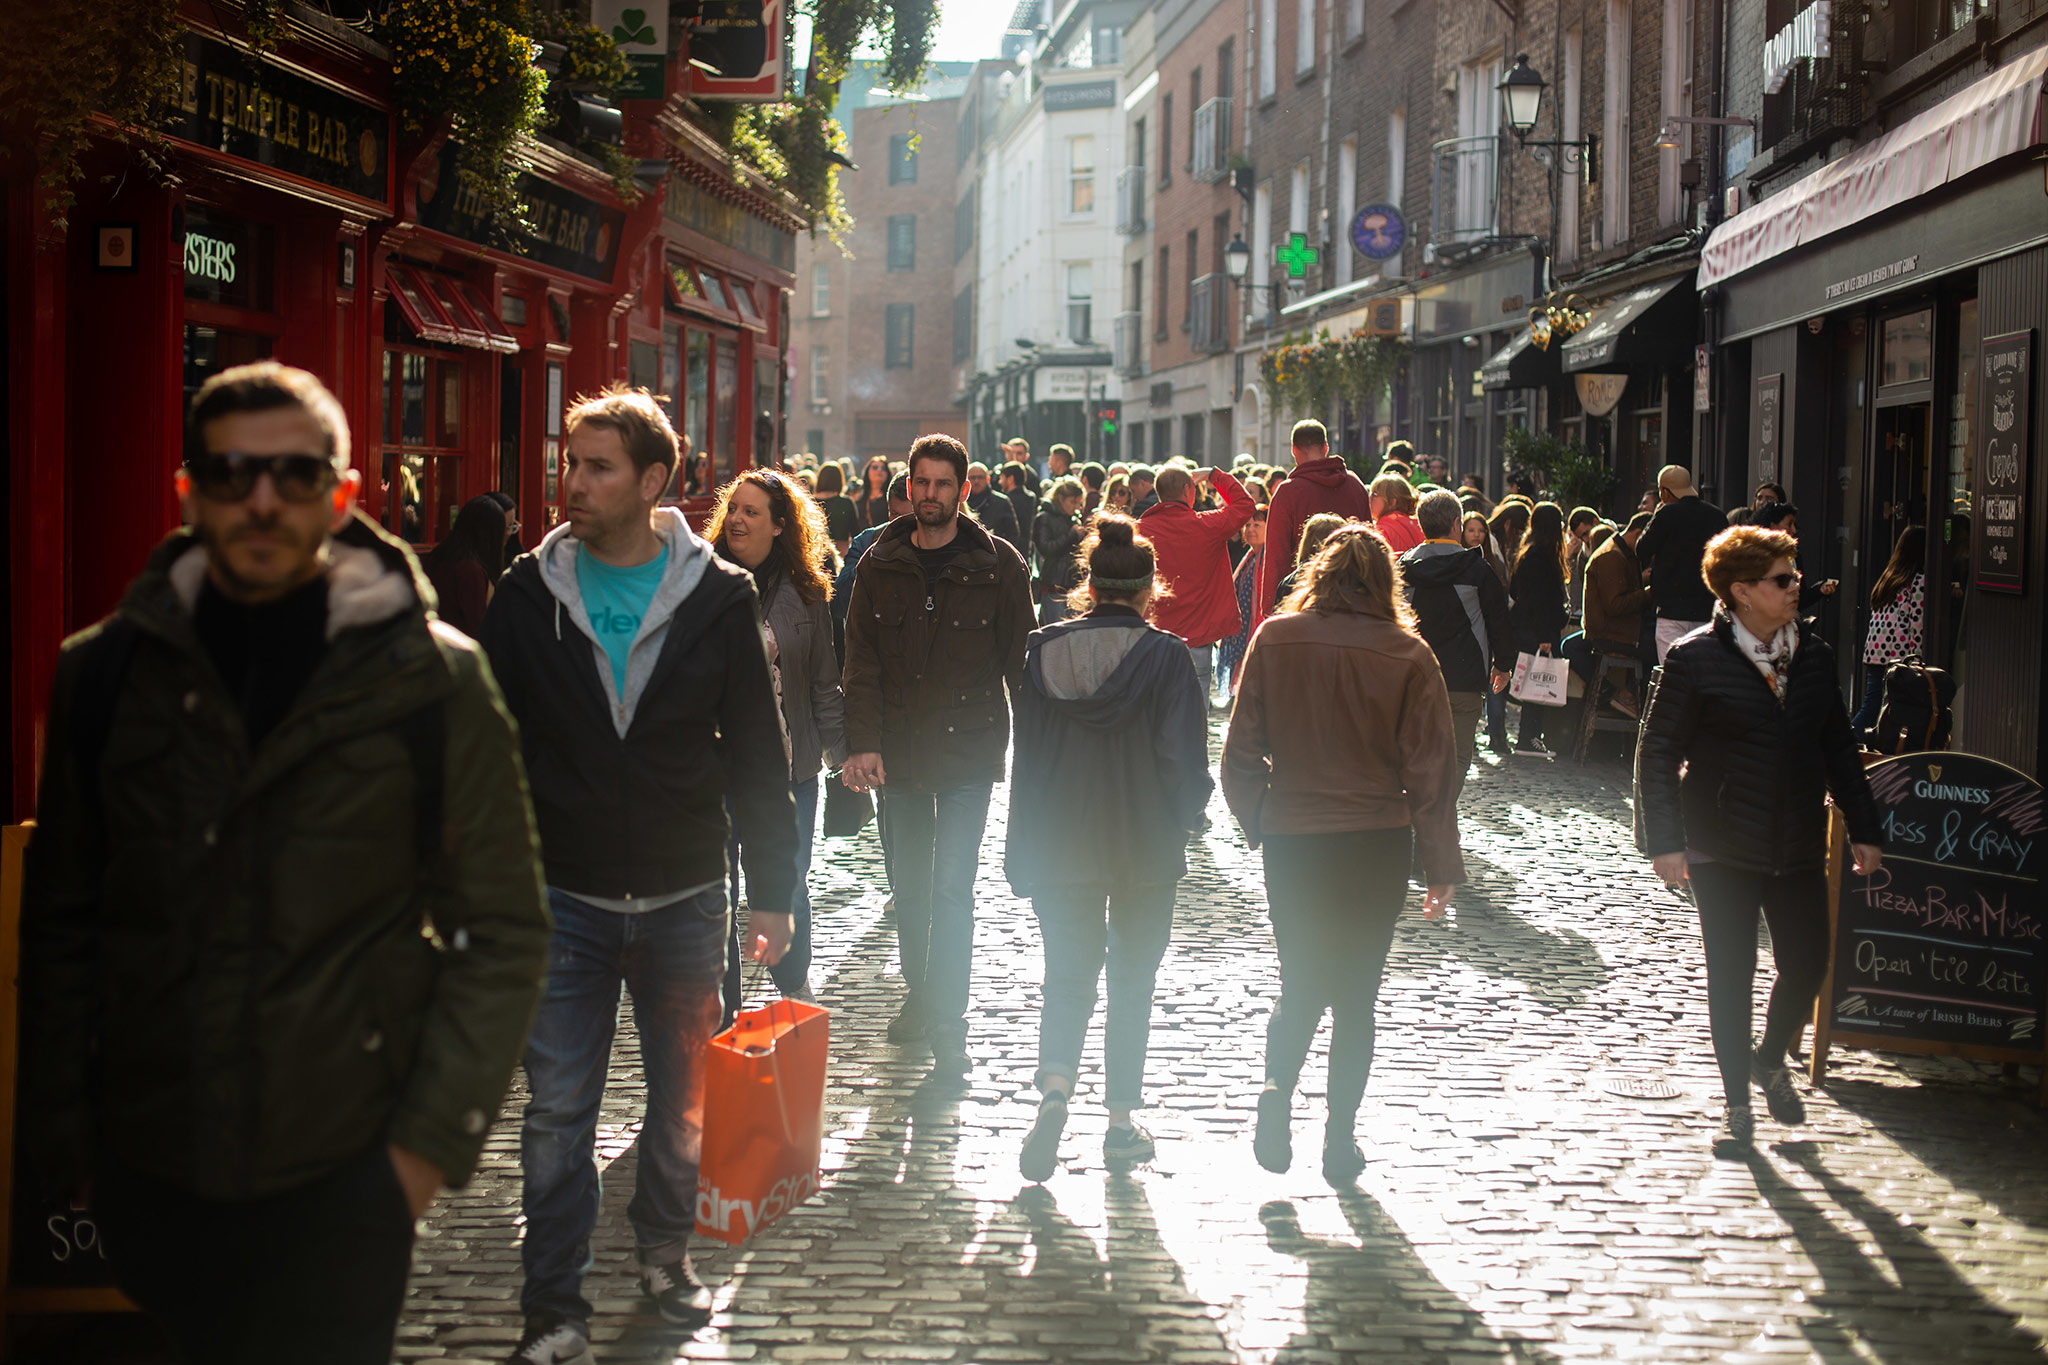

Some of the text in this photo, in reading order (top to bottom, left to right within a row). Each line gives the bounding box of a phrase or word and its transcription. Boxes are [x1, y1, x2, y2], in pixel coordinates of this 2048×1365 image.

[205, 72, 299, 149] TEMPLE
[307, 111, 348, 167] BAR
[556, 208, 589, 254] BAR
[183, 231, 236, 284] YSTERS
[1998, 499, 2016, 521] CREAM
[589, 606, 642, 635] rle
[1914, 780, 1991, 805] GUINNESS
[1934, 809, 1962, 862] &
[1856, 940, 1913, 982] Open
[1976, 960, 2033, 995] late
[1893, 1007, 1916, 1019] taste
[1917, 1009, 1931, 1023] of
[1932, 1009, 1963, 1024] IRISH
[1967, 1012, 2003, 1028] BEERS
